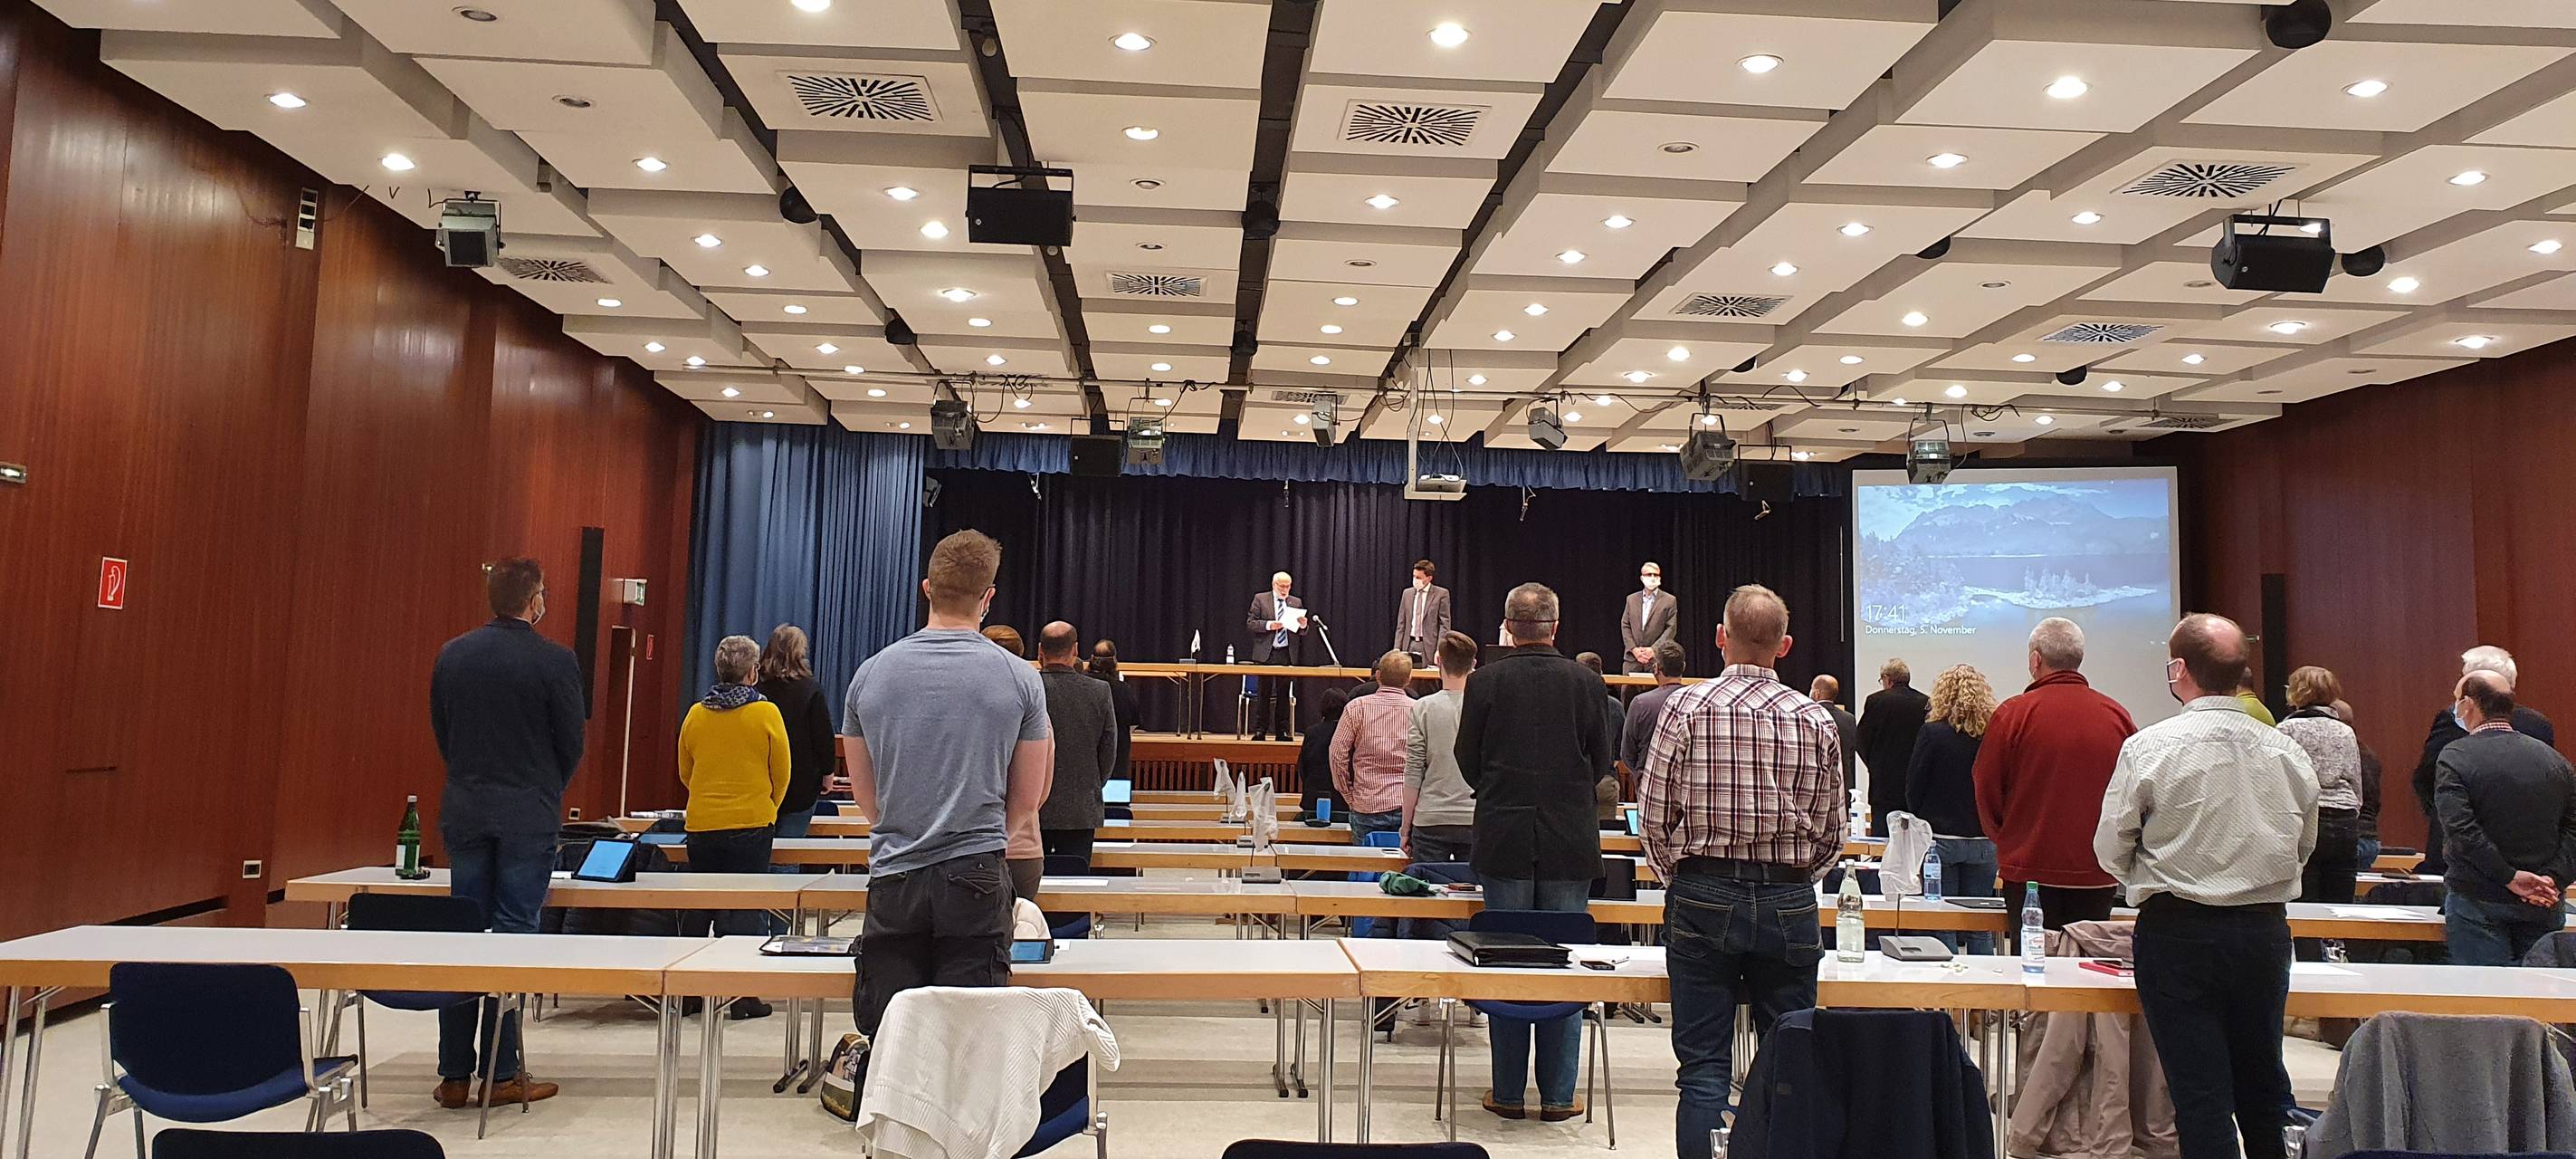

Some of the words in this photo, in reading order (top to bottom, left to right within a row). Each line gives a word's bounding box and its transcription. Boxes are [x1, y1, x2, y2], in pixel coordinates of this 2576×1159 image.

[1865, 604, 1906, 622] 17:41
[1865, 625, 1917, 637] Donnerstag,
[1920, 626, 1928, 635] 5.
[1930, 625, 1977, 635] November
